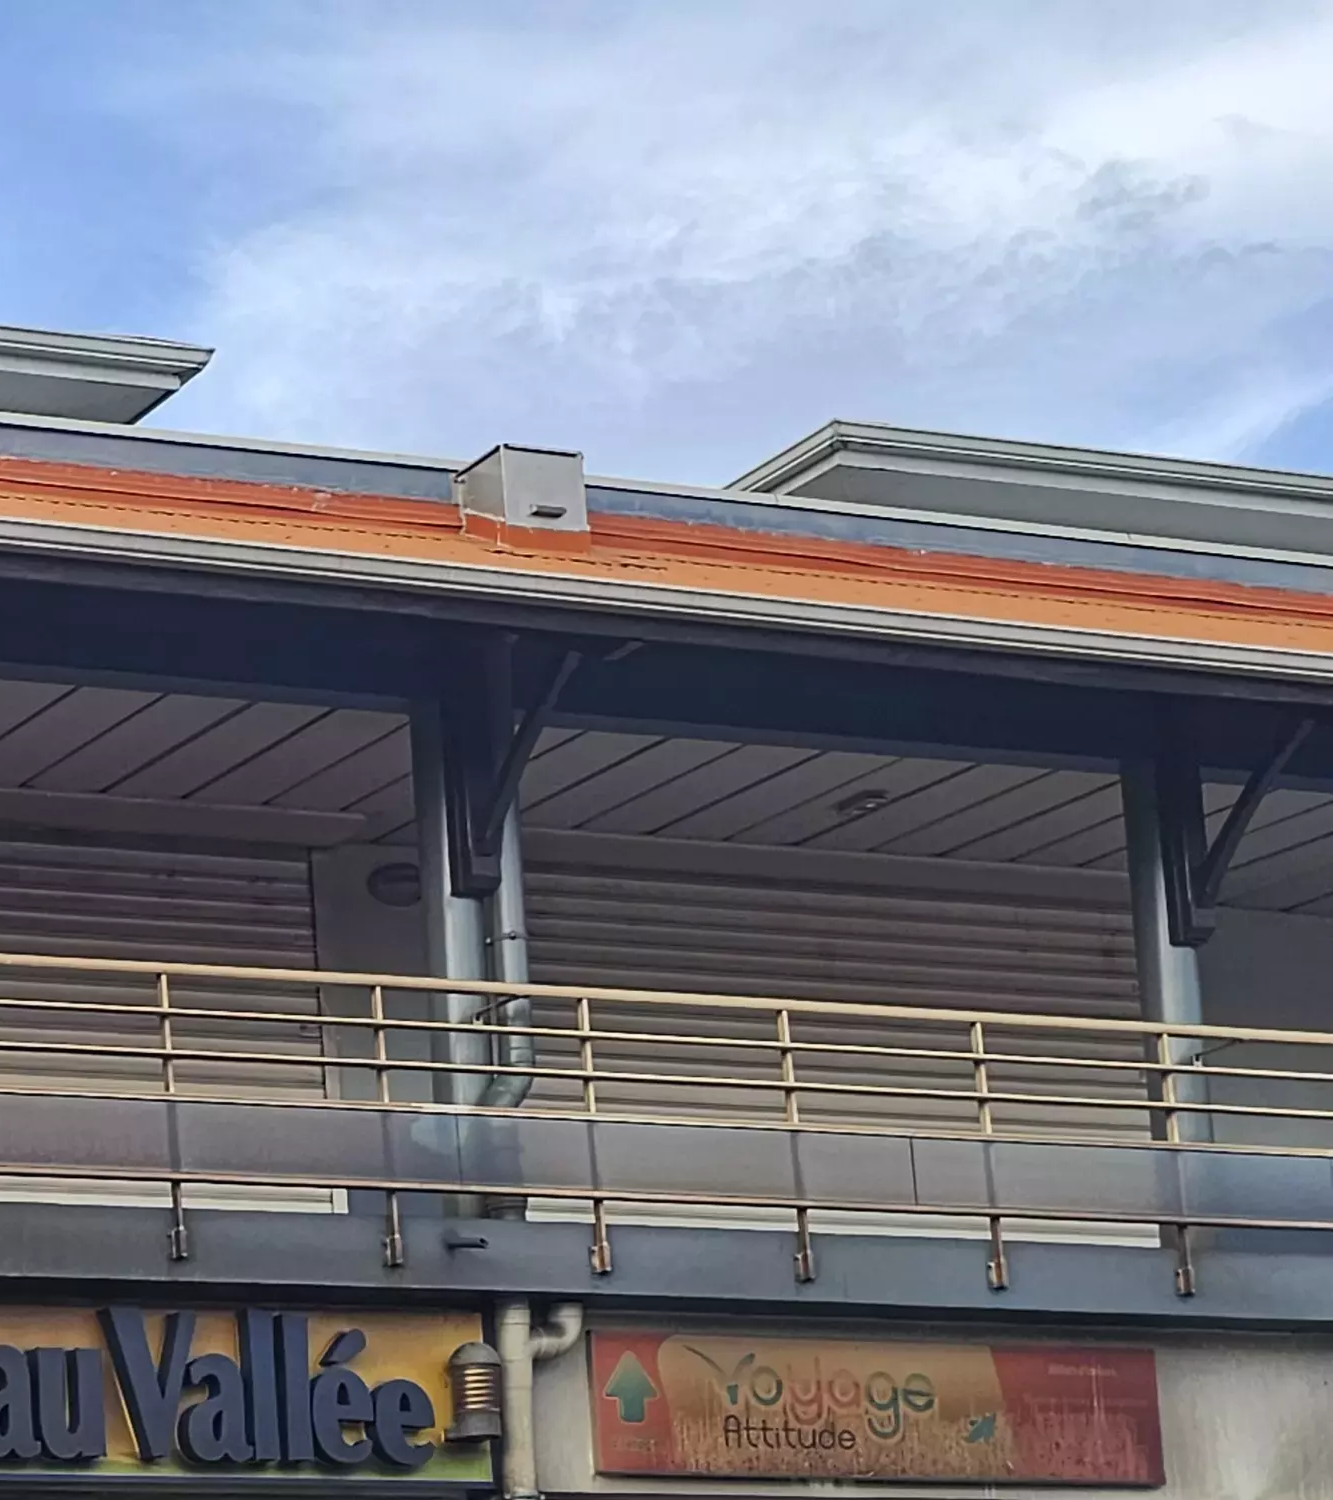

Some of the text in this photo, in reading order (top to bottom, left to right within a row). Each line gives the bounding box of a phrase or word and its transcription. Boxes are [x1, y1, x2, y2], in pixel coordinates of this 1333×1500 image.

[96, 1307, 436, 1466] Vallée
[682, 1343, 937, 1441] Voyage
[722, 1413, 857, 1450] Attitude
